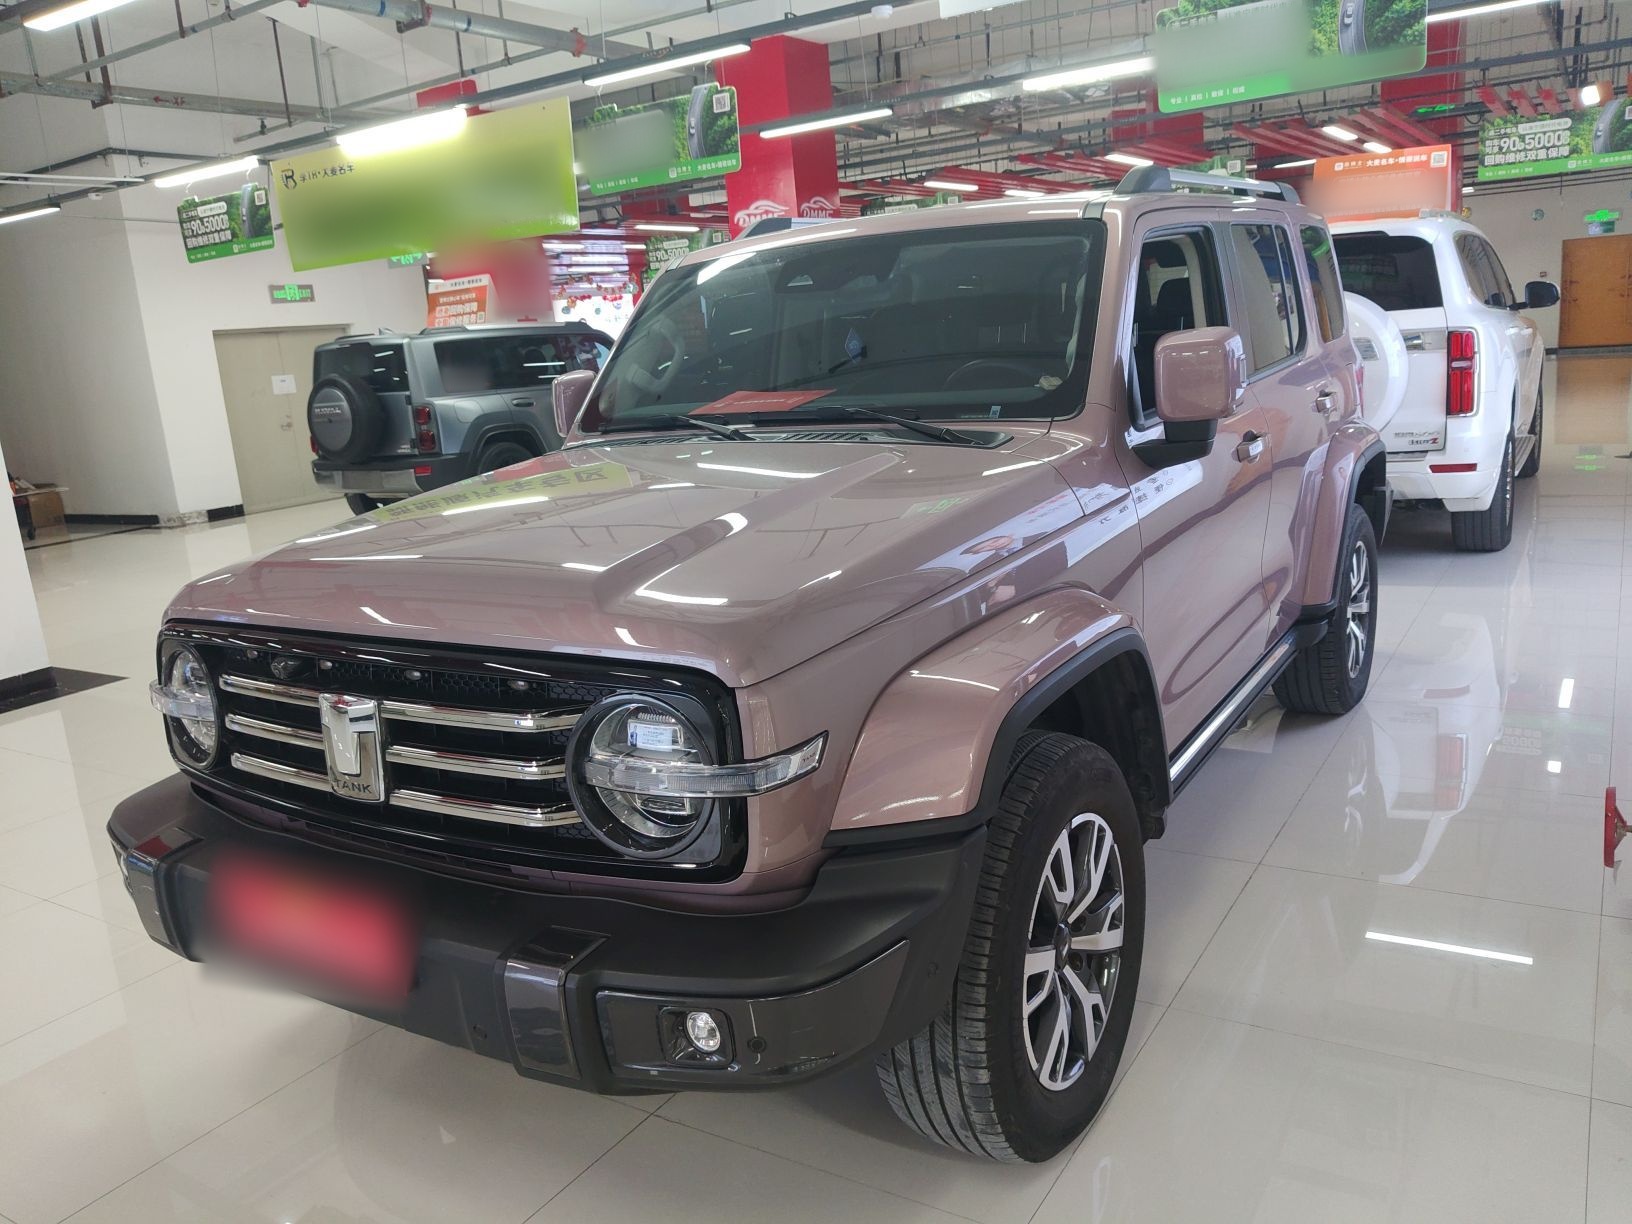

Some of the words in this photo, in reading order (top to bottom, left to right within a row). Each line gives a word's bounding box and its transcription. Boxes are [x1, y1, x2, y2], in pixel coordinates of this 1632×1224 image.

[1484, 146, 1570, 166] 回购维修双重保障
[334, 779, 372, 794] TANK
